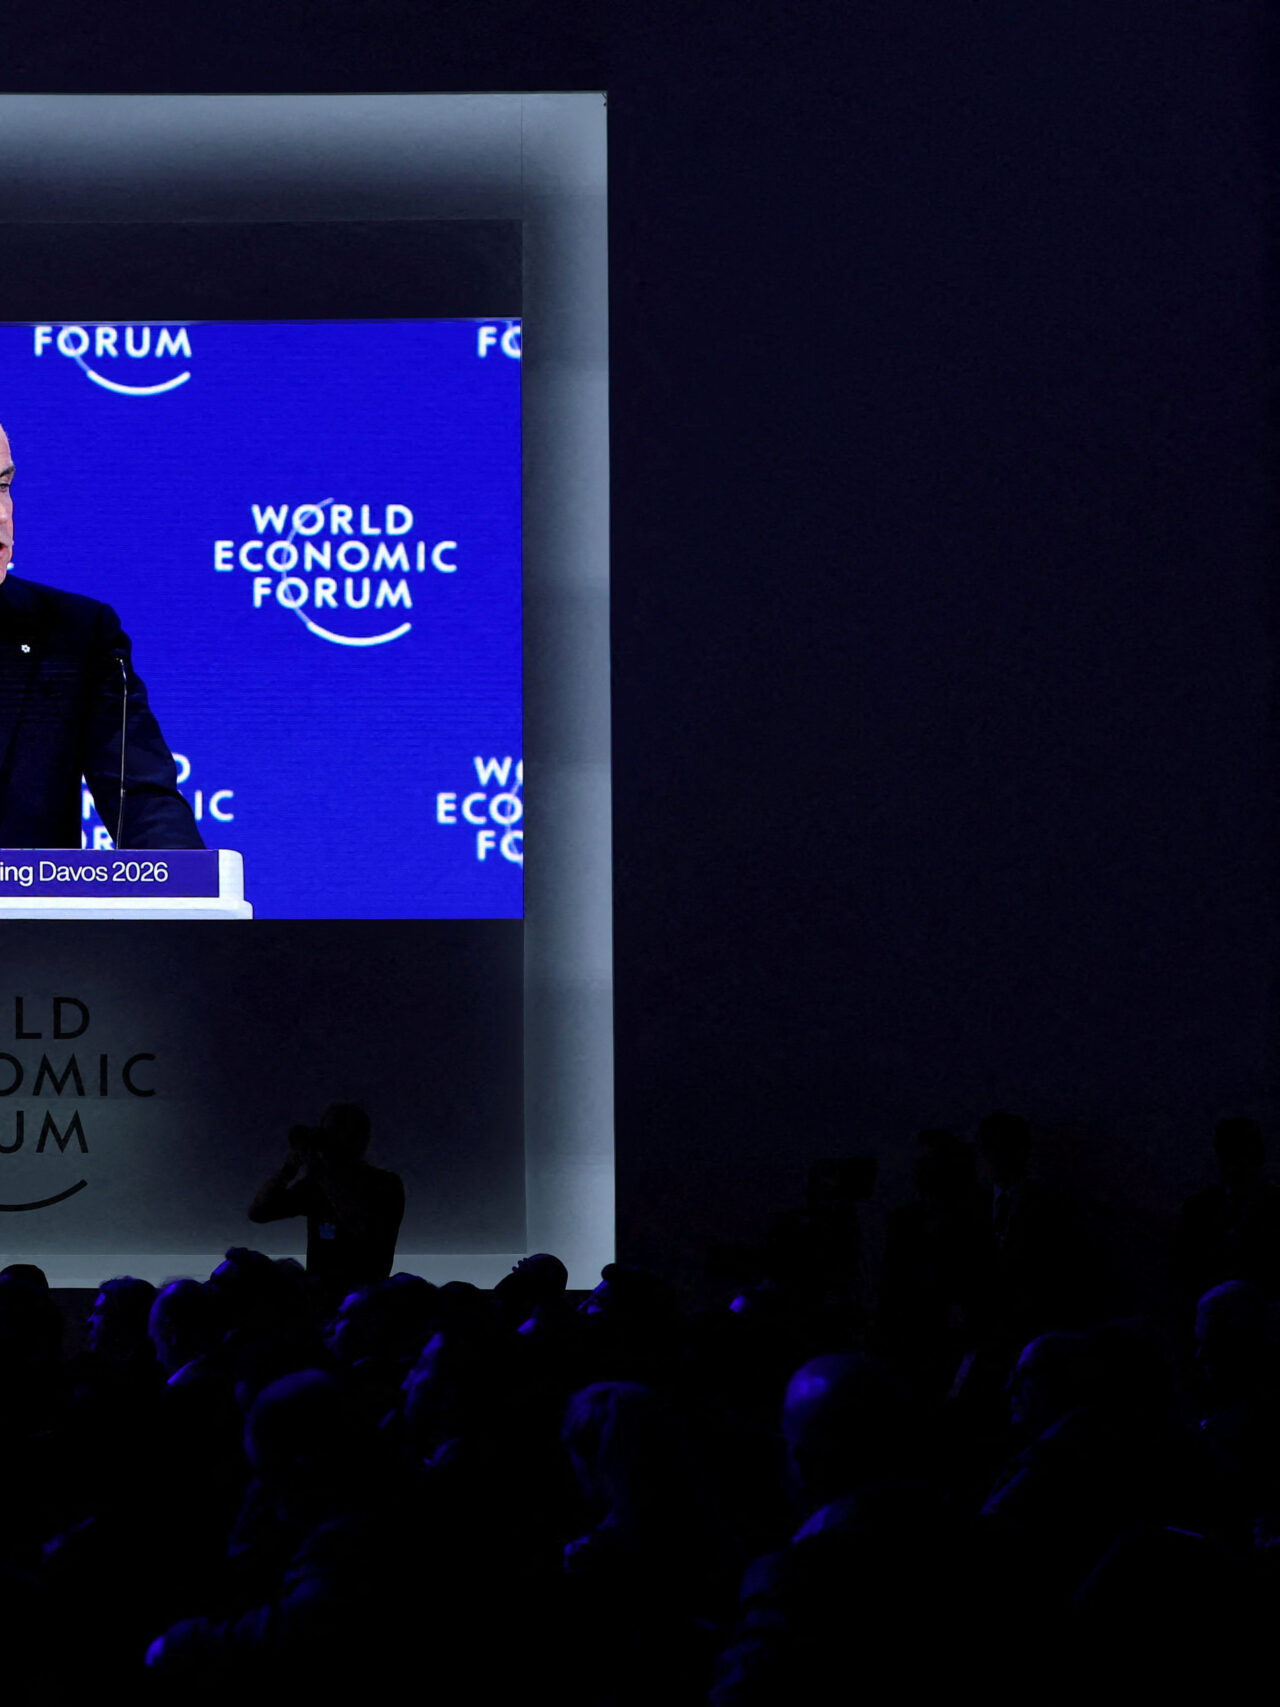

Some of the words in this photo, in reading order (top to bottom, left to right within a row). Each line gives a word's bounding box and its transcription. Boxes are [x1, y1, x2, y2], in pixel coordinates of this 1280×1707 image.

[34, 326, 192, 357] FORUM
[251, 504, 414, 536] WORLD
[214, 540, 457, 572] ECONOMIC
[253, 577, 413, 609] FORUM
[39, 860, 109, 882] Davos
[112, 861, 169, 883] 2026
